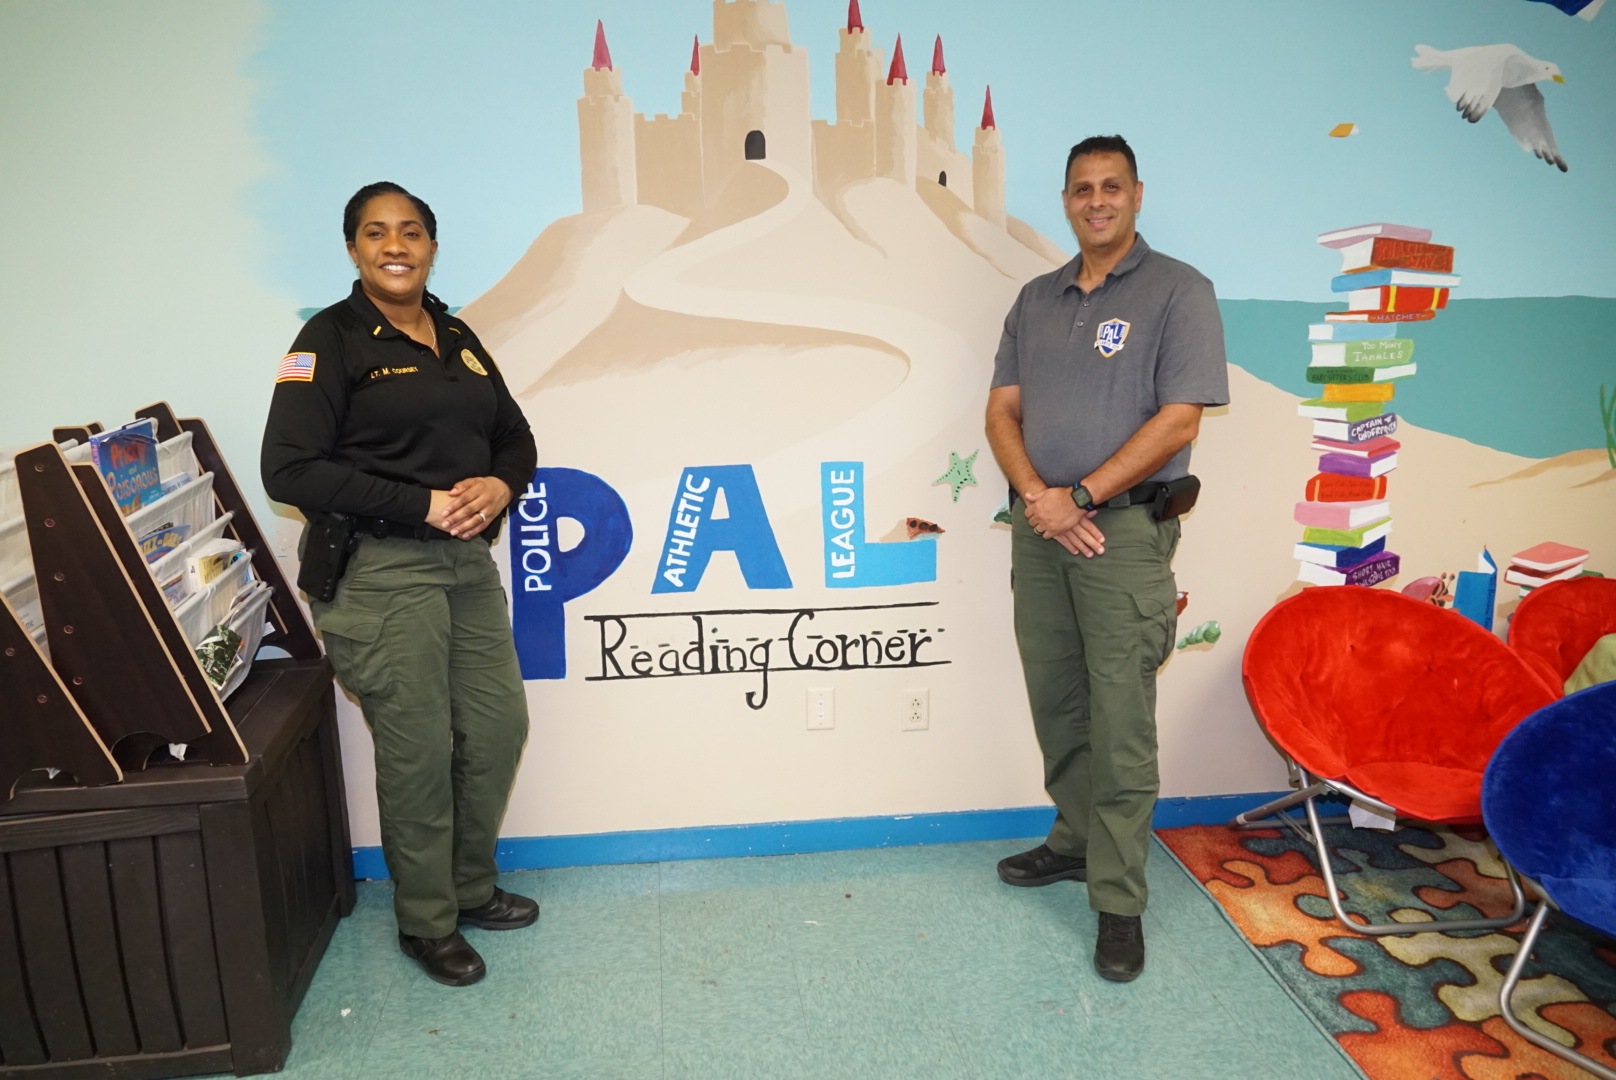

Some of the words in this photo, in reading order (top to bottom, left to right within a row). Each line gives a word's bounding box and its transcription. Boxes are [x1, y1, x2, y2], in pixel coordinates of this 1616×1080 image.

[1102, 325, 1119, 342] PAL
[1353, 350, 1404, 362] TAMALES
[370, 370, 381, 379] LT.
[381, 367, 391, 376] M.
[1351, 417, 1383, 437] CAPTAIN
[1358, 421, 1397, 441] UNDERPANTS
[663, 473, 711, 588] ATHLETIC
[830, 469, 856, 579] LEAGUE
[518, 481, 552, 592] POLICE
[508, 461, 937, 680] PAL
[1352, 563, 1373, 582] SHORT
[600, 615, 773, 711] Reading
[789, 609, 932, 670] Corner
